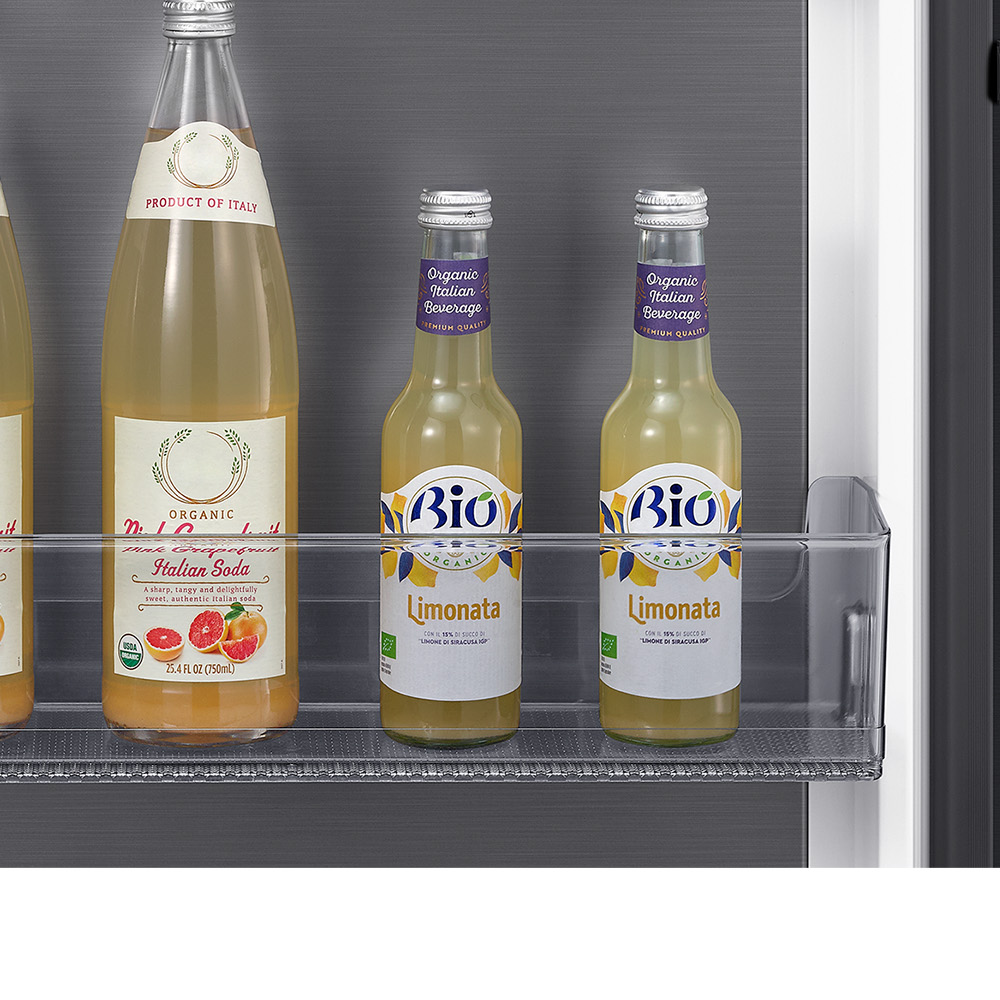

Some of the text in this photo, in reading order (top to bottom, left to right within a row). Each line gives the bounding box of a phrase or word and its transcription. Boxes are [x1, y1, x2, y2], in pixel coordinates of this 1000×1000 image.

[145, 197, 257, 213] PRODUCT OF ITALY
[427, 266, 479, 285] Organic
[646, 272, 699, 290] Organic
[430, 284, 476, 298] Italian
[649, 290, 696, 303] Italian
[424, 300, 482, 318] Beverage
[642, 305, 702, 324] Beverage
[421, 320, 487, 332] PREMIUM QUALITY
[640, 325, 706, 339] PREMIUM QUALITY
[169, 509, 234, 520] ORGANIC
[151, 558, 251, 578] Italian Soda
[150, 586, 173, 595] sharp,
[175, 587, 197, 595] tangy
[216, 585, 258, 595] delightfully
[407, 594, 501, 625] Limonata
[628, 593, 720, 625] Limonata
[122, 641, 138, 651] USDA
[121, 652, 140, 661] ORGANIC
[166, 663, 236, 676] 25.4 FL OZ (750mL)
